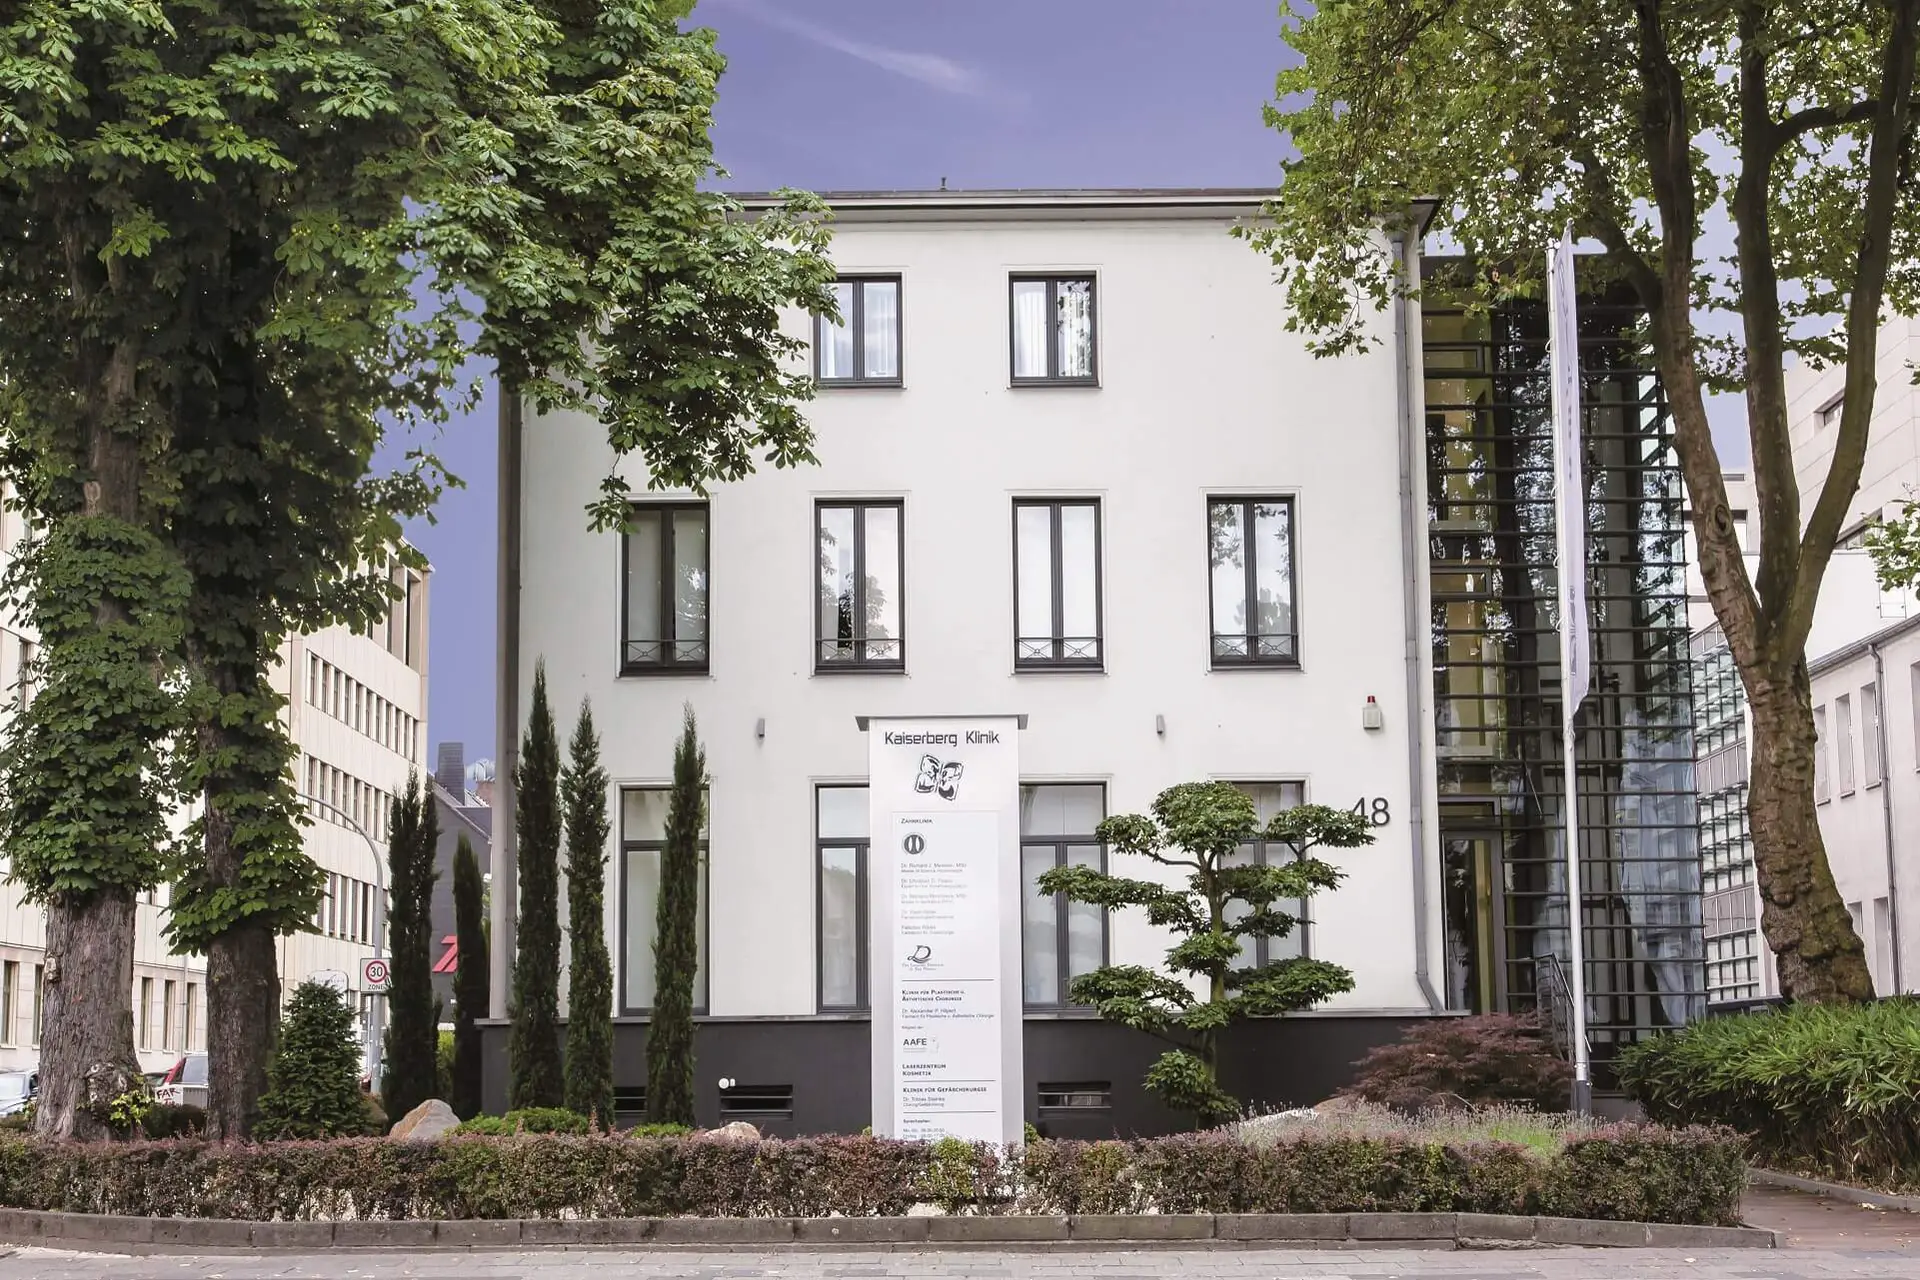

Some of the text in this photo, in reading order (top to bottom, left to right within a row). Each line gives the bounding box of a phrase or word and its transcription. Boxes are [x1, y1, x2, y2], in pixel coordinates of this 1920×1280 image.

[884, 730, 1000, 747] Kaiserberg Klinik
[1351, 797, 1390, 826] 48
[370, 967, 383, 977] 30
[903, 1038, 927, 1046] AAFE
